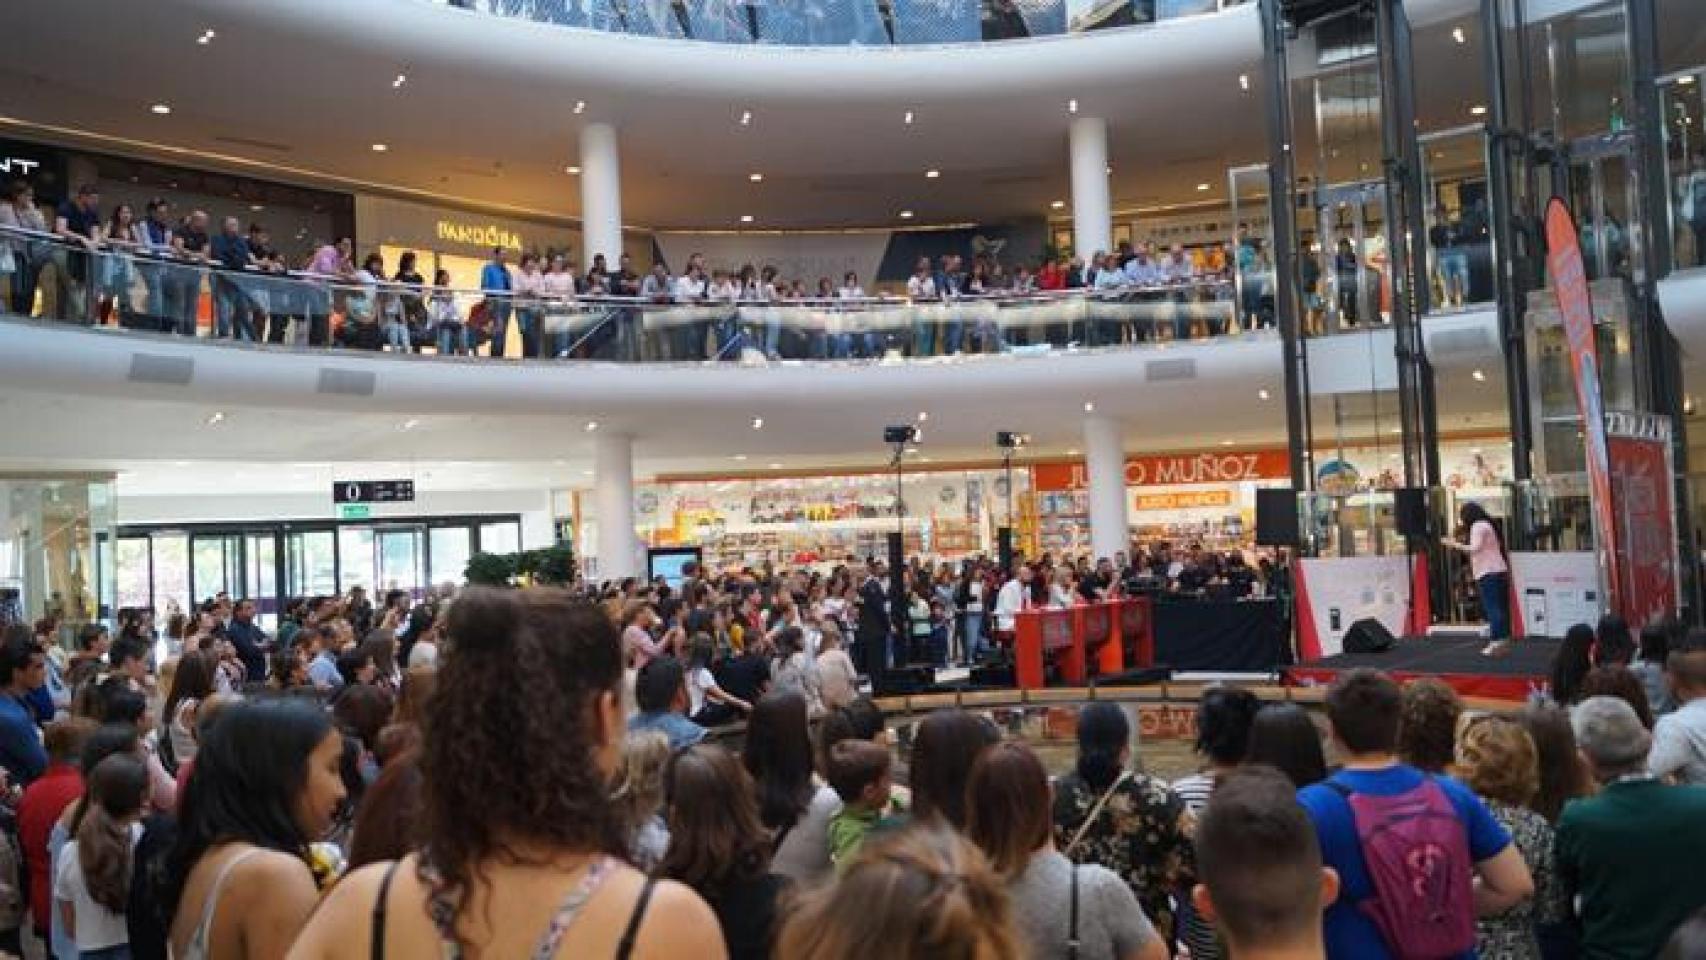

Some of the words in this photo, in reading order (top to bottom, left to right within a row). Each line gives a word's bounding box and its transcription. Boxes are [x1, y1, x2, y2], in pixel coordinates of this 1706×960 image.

[437, 221, 521, 249] PANDORA
[1069, 461, 1145, 488] JUO
[1155, 455, 1260, 483] MUÑOZ
